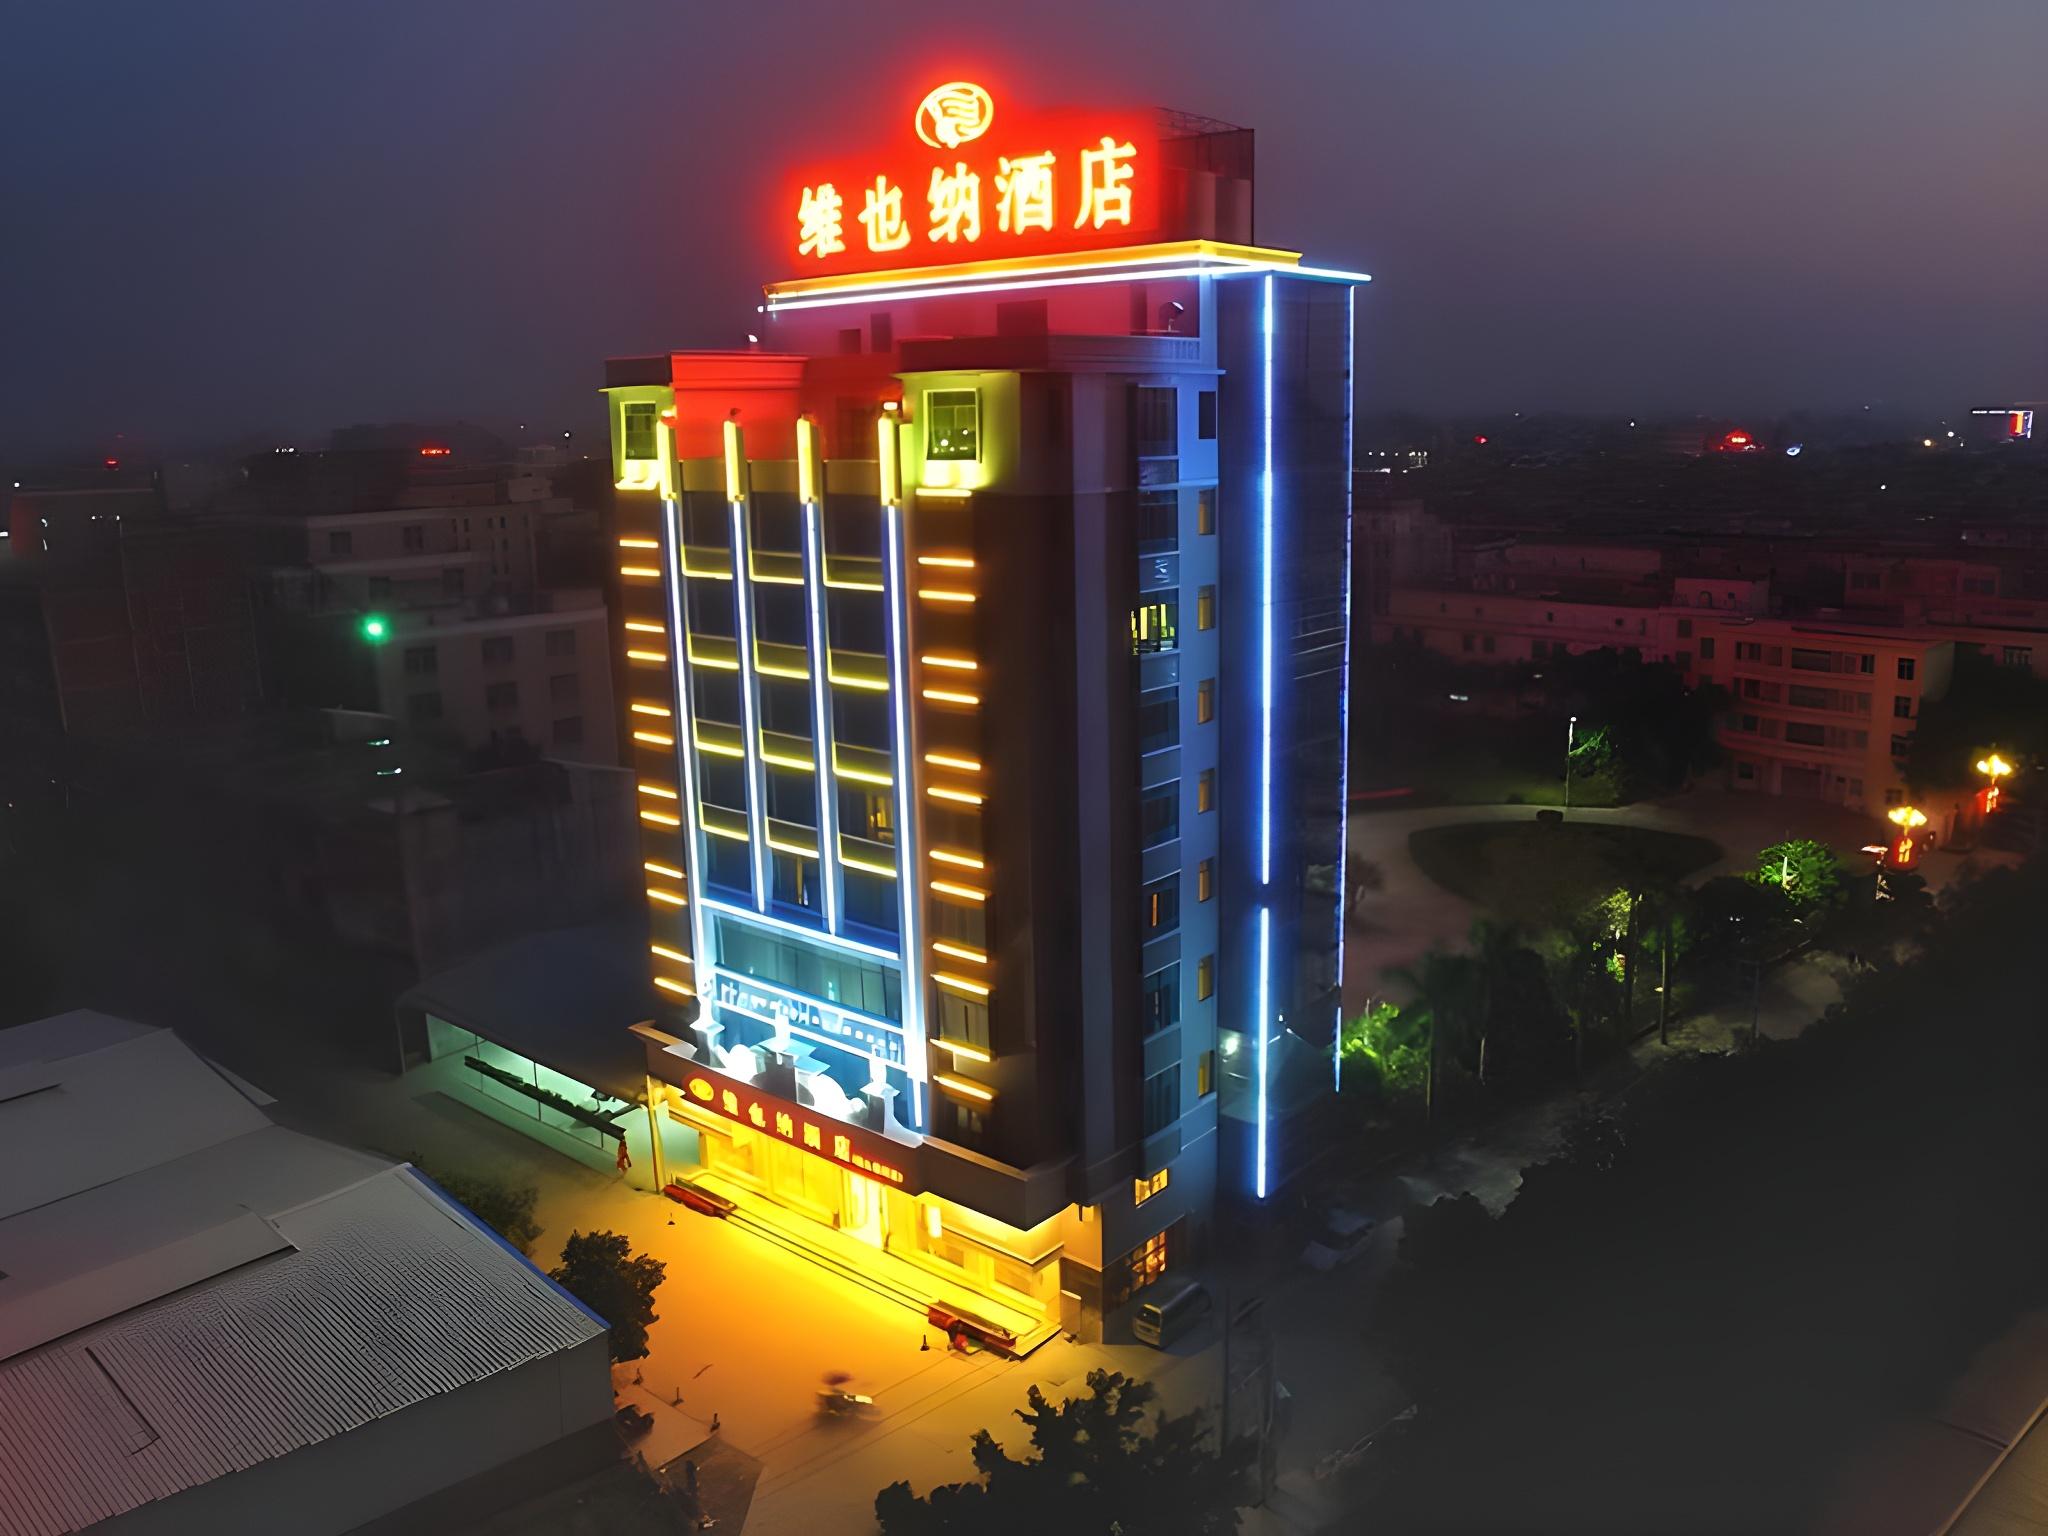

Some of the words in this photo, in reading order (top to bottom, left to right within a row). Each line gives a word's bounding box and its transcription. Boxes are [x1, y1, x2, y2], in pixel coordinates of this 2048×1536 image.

[798, 136, 1137, 258] 维也纳酒店
